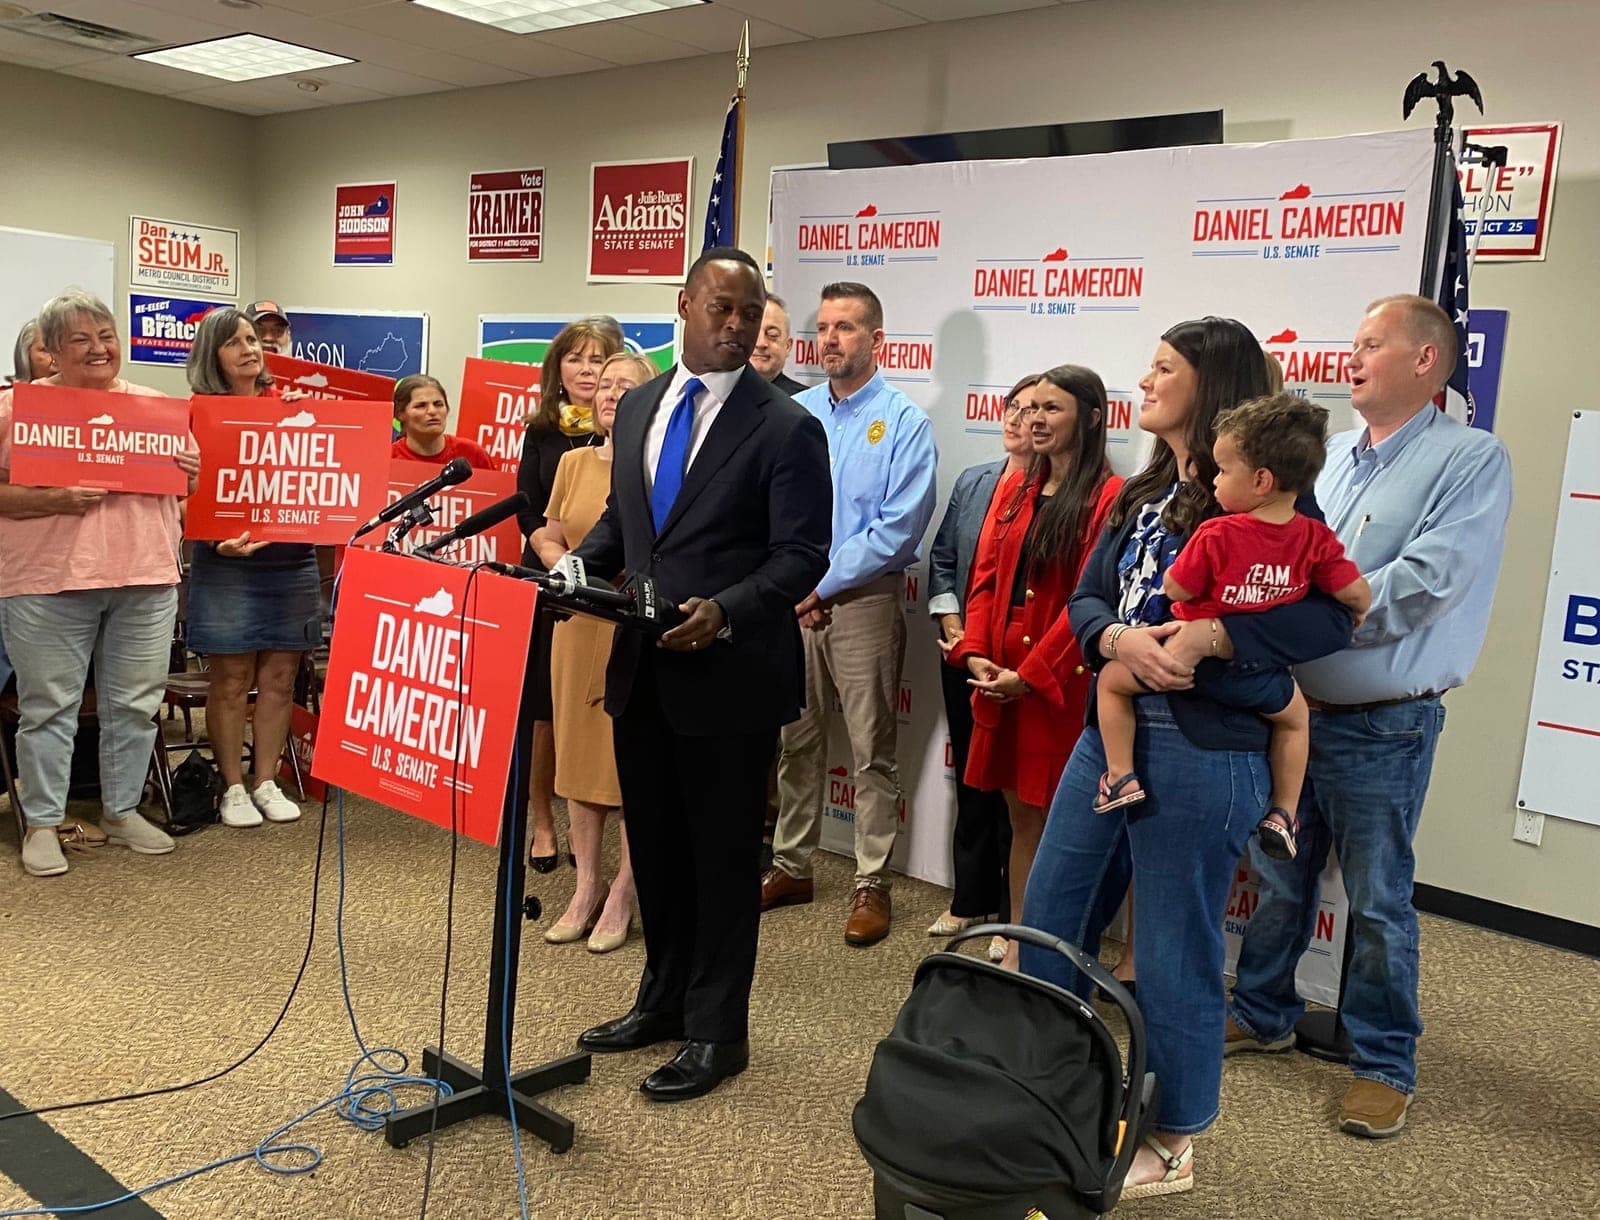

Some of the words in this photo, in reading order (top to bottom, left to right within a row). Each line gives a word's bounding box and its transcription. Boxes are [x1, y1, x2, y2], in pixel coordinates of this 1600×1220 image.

[520, 173, 541, 187] Vote
[637, 190, 657, 204] Julie
[338, 205, 365, 217] JOHN
[469, 191, 542, 235] KRAMER
[594, 193, 684, 231] Adams
[1193, 208, 1273, 242] DANIEL
[1281, 201, 1405, 240] CAMERON
[140, 220, 167, 238] Dan
[338, 217, 390, 234] HODGSON
[799, 224, 852, 250] DANIEL
[858, 220, 940, 250] CAMERON
[1507, 222, 1524, 232] 25
[138, 236, 202, 270] SEUM
[204, 252, 229, 273] JR.
[603, 240, 634, 250] STATE
[638, 239, 675, 250] SENATE
[1263, 246, 1281, 259] U.S.
[1284, 245, 1320, 259] SENATE
[846, 255, 859, 266] U.S.
[861, 254, 885, 266] SENATE
[138, 267, 162, 278] METRO
[162, 270, 190, 282] COUNCIL
[192, 275, 220, 285] DISTRICT
[221, 278, 229, 287] 13
[974, 268, 1038, 297] DANIEL
[1045, 267, 1143, 297] CAMERON
[134, 300, 171, 314] RE-ELECT
[1030, 302, 1046, 314] U.S.
[1047, 302, 1077, 315] SENATE
[291, 341, 345, 369] ASON
[875, 343, 933, 369] MERON
[14, 421, 86, 449] DANIEL
[91, 428, 186, 456] CAMERON
[239, 430, 341, 468] DANIEL
[78, 453, 94, 463] U.S.
[95, 453, 126, 465] SENATE
[216, 468, 361, 507] CAMERON
[251, 508, 273, 523] U.S.
[277, 509, 321, 525] SENATE
[1244, 563, 1290, 586] TEAM
[371, 611, 470, 695] DANIEL
[344, 670, 487, 770] CAMERON
[371, 744, 393, 772] U.S.
[395, 752, 440, 790] SENATE
